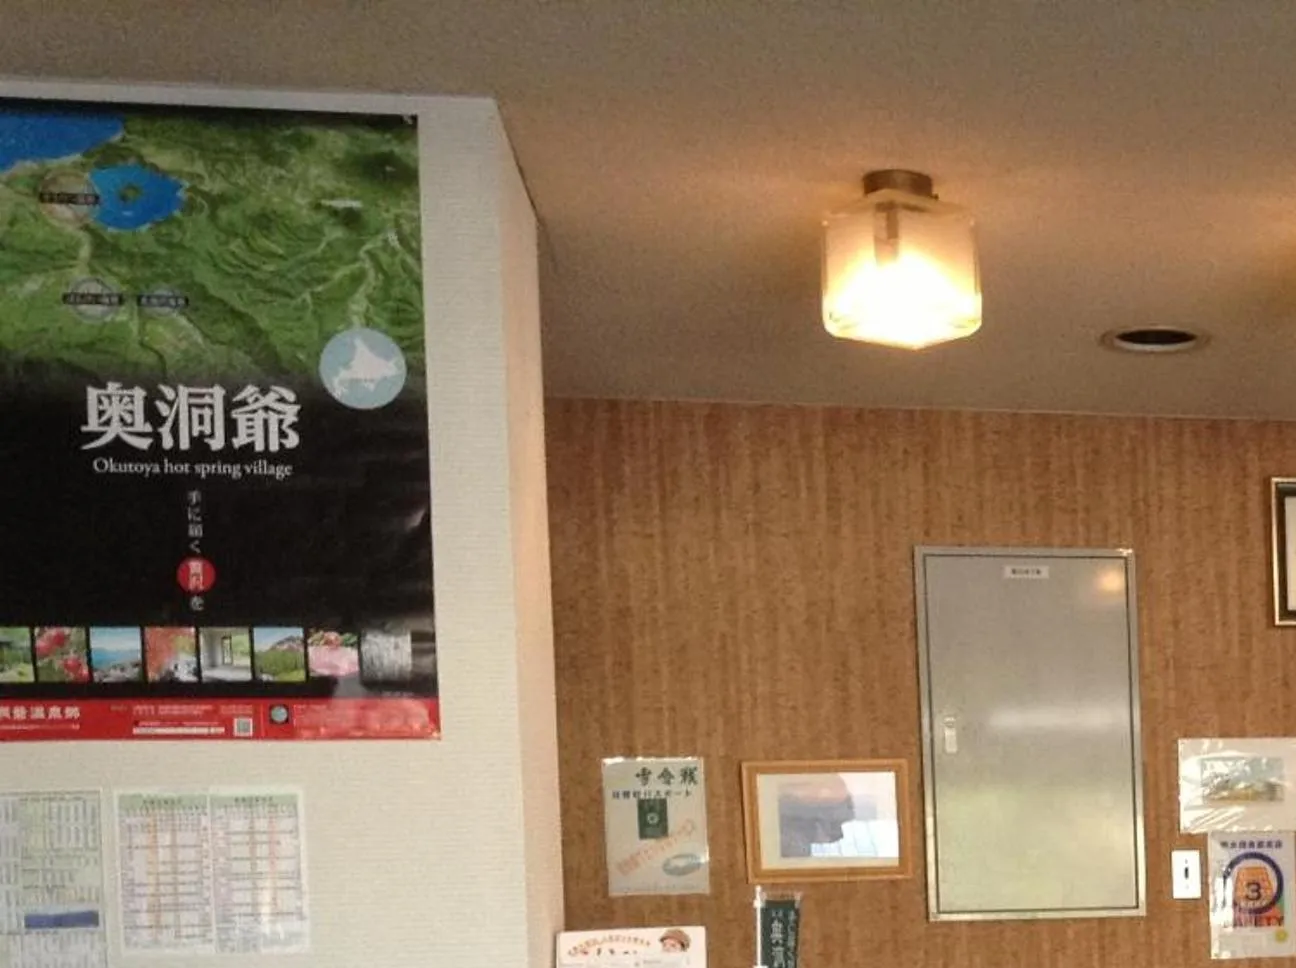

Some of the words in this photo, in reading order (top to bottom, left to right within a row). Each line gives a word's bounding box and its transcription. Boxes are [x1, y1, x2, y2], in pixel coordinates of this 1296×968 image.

[80, 382, 302, 453] 奥洞爺
[93, 457, 161, 477] Okutoya
[164, 458, 191, 474] hot
[194, 459, 242, 479] spring
[244, 458, 293, 479] village
[1246, 881, 1262, 901] 3
